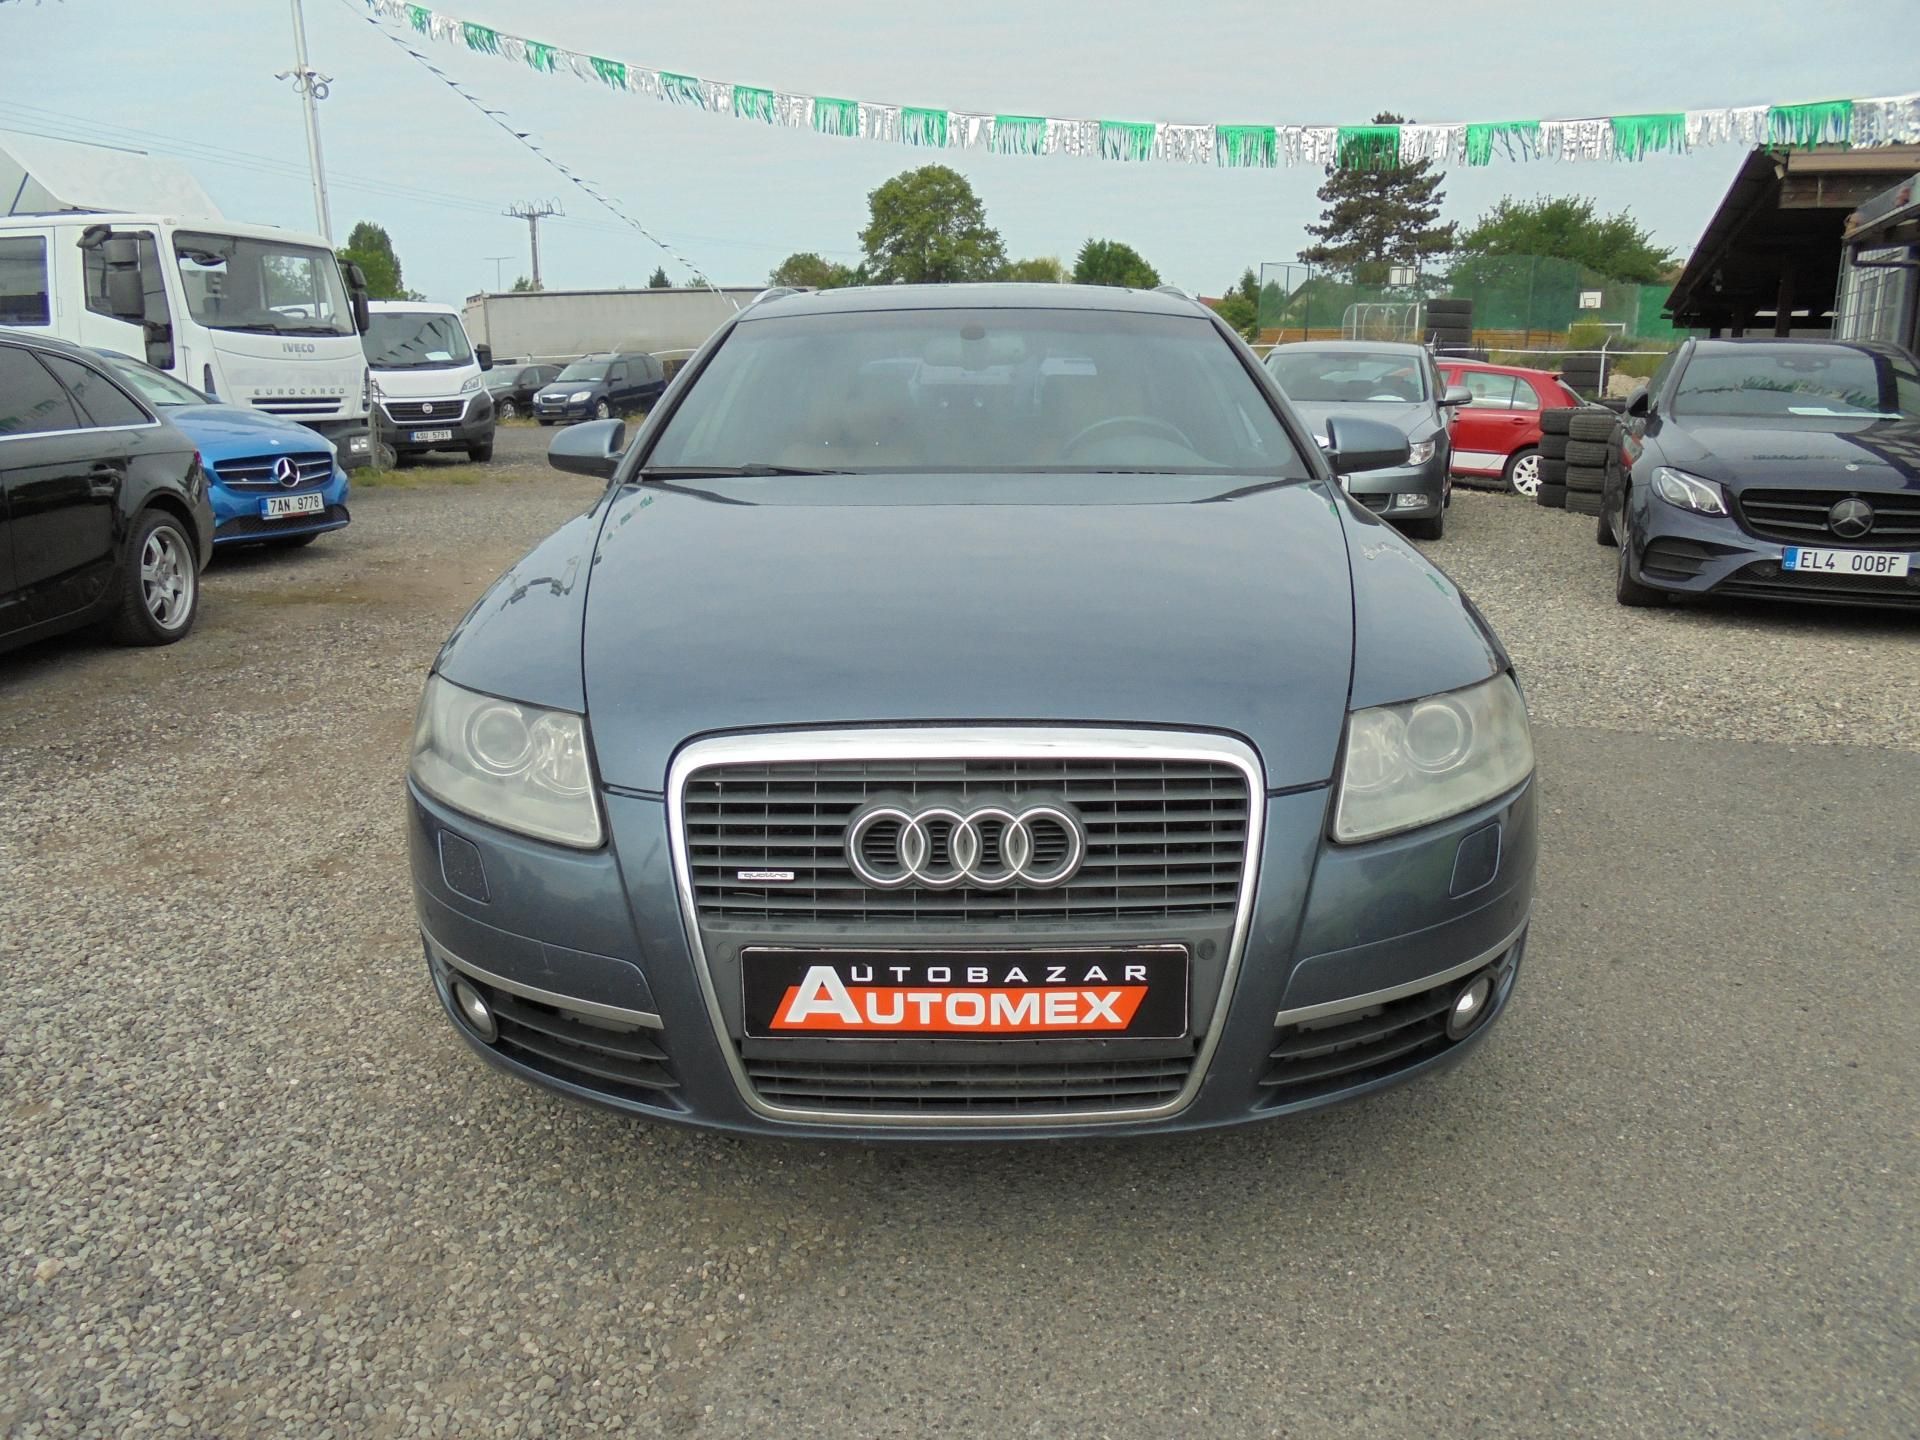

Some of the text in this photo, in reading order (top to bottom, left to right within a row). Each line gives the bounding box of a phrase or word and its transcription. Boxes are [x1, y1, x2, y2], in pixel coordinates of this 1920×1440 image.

[282, 343, 316, 353] IVECO
[253, 387, 345, 396] EUROCARGO
[270, 495, 320, 514] 7AN 9778
[1800, 551, 1900, 573] EL4 00BF
